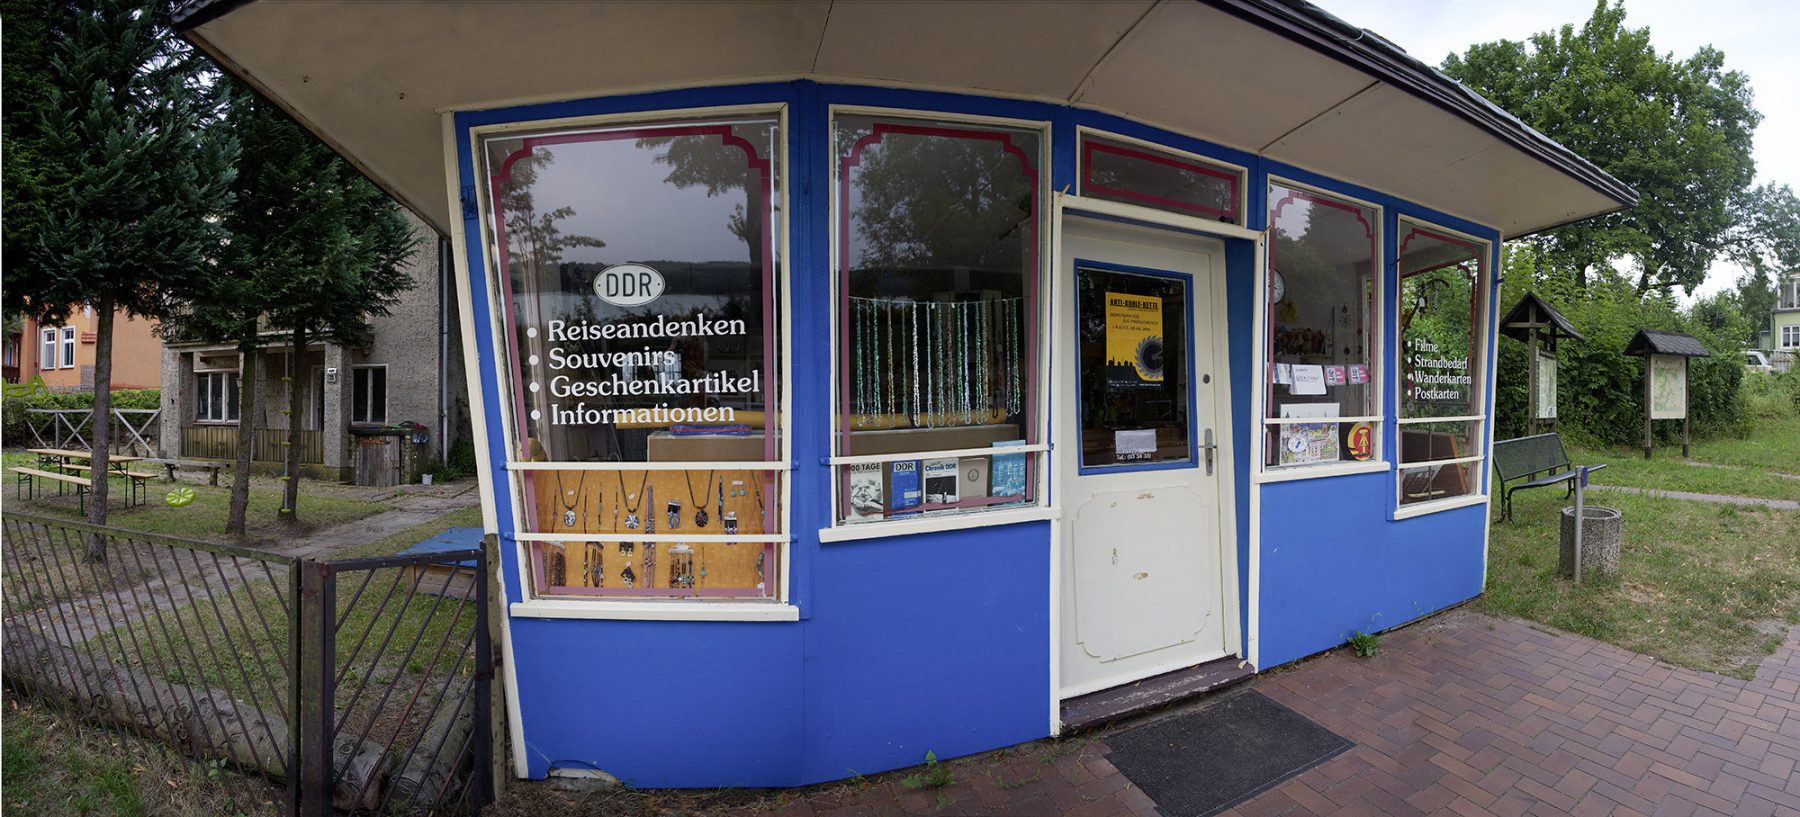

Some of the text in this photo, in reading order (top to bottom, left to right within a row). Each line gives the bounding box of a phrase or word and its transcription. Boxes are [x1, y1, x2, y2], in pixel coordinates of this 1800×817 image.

[606, 272, 652, 297] DDR
[548, 313, 746, 342] Reiseandenken
[1415, 338, 1438, 352] Filme
[549, 346, 676, 370] Souvenirs
[1415, 354, 1468, 369] Strandbedarf
[550, 369, 760, 398] Geschenkartikel
[1415, 370, 1472, 385] Wanderkarten
[1415, 386, 1459, 399] Postkarten
[551, 402, 735, 425] Informationen
[861, 462, 880, 471] TAGE
[895, 462, 914, 471] DDR
[945, 462, 957, 470] DDR
